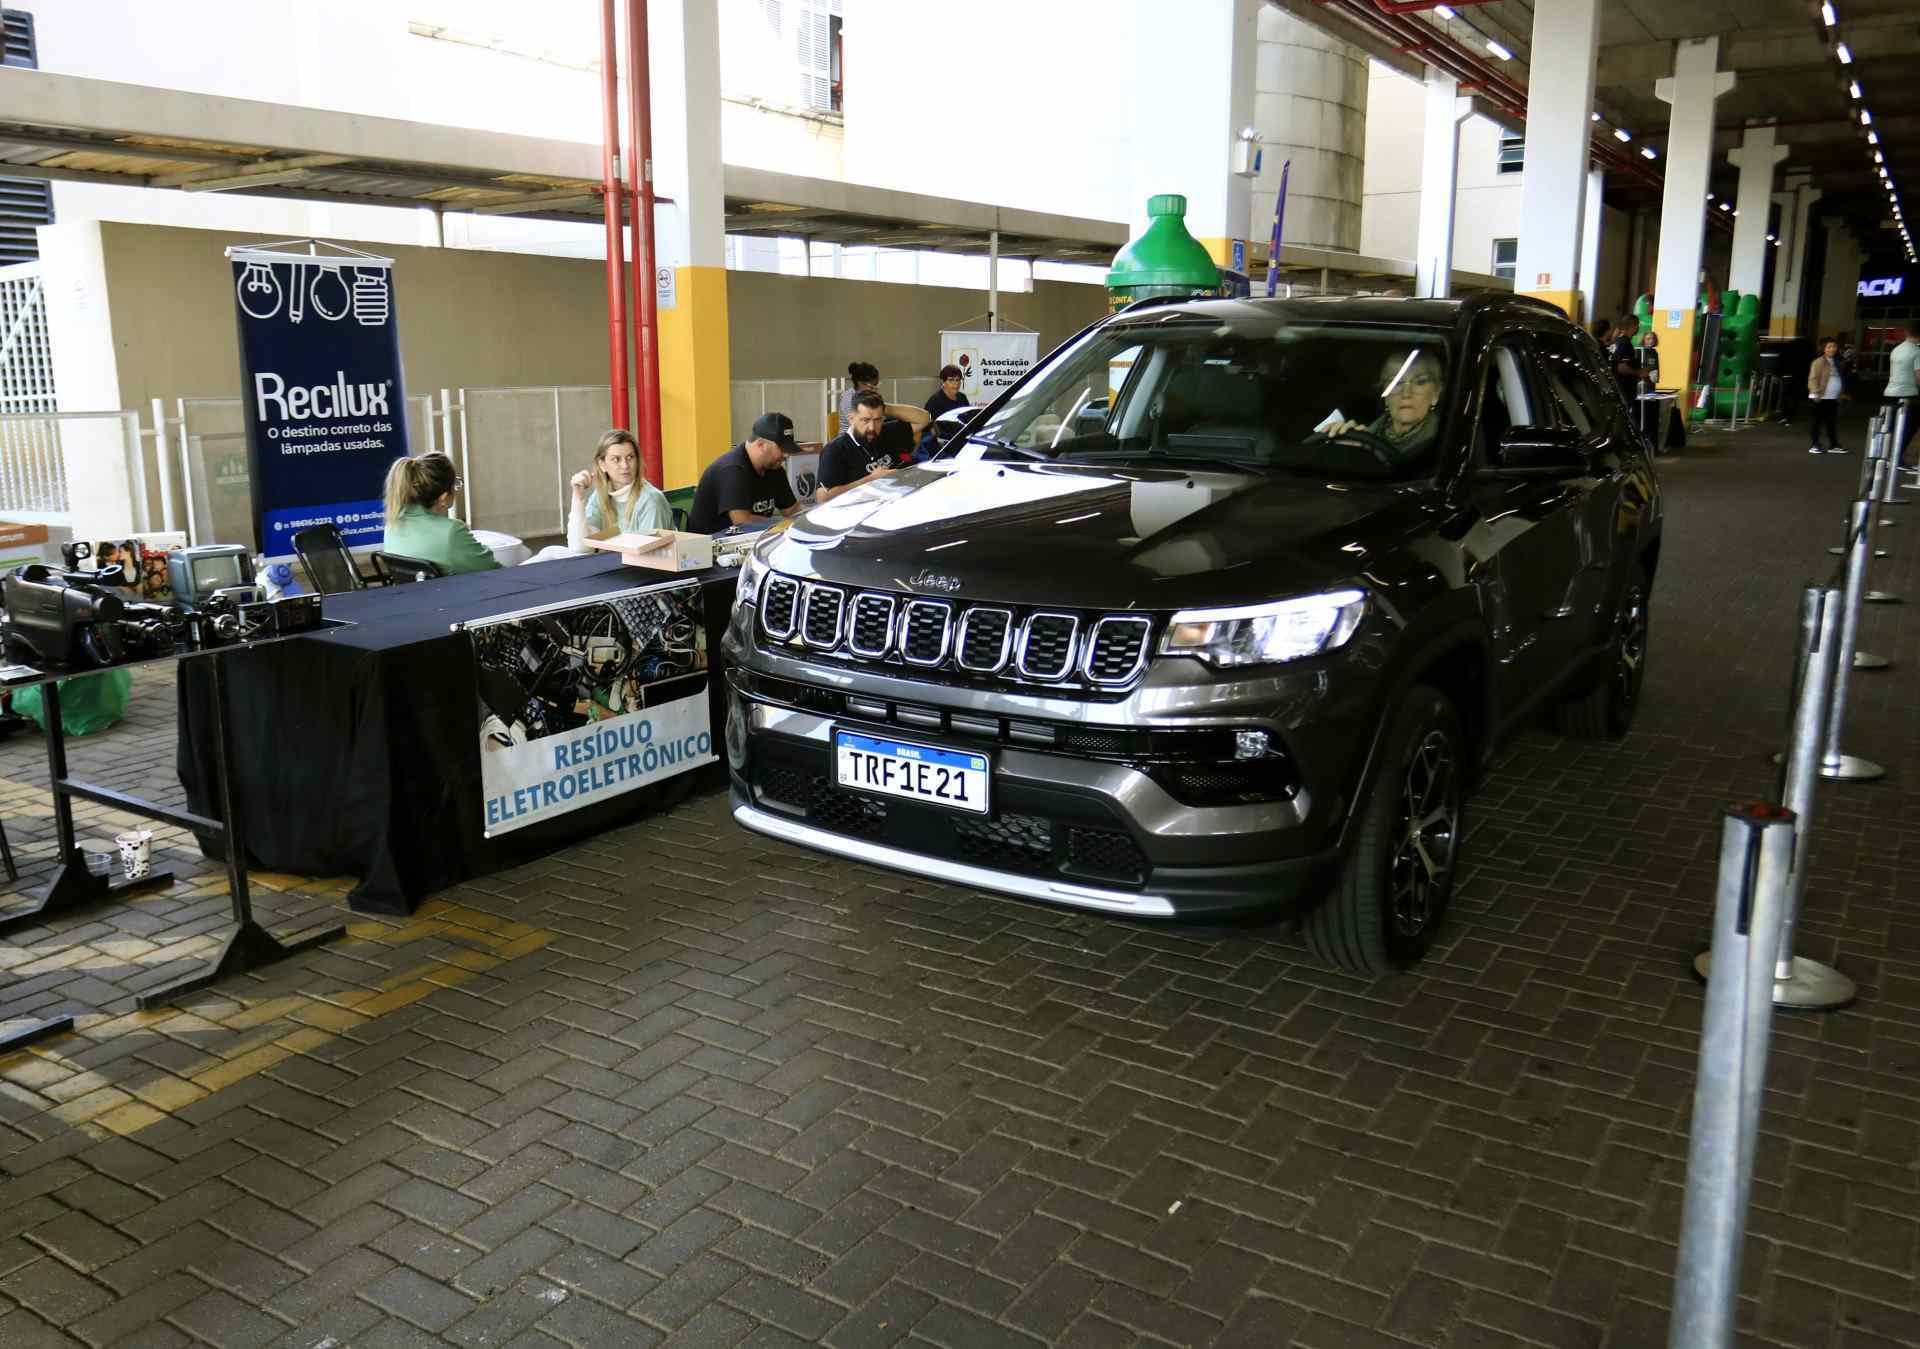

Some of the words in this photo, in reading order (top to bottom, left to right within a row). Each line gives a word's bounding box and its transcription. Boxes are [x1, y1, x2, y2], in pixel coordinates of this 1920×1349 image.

[1857, 278, 1902, 297] ACH
[980, 358, 1030, 368] Associação
[254, 371, 389, 421] Recilux
[267, 427, 279, 439] O
[281, 425, 328, 438] destino
[330, 422, 371, 435] correto
[373, 421, 392, 432] das
[281, 440, 341, 455] lâmpadas
[343, 438, 385, 450] usadas.
[909, 568, 961, 592] Jeep
[554, 720, 652, 770] RESÍDUO
[896, 747, 921, 759] BRASIL
[486, 731, 711, 826] ELETROELETRÔNICO
[849, 751, 969, 802] TRF1E21
